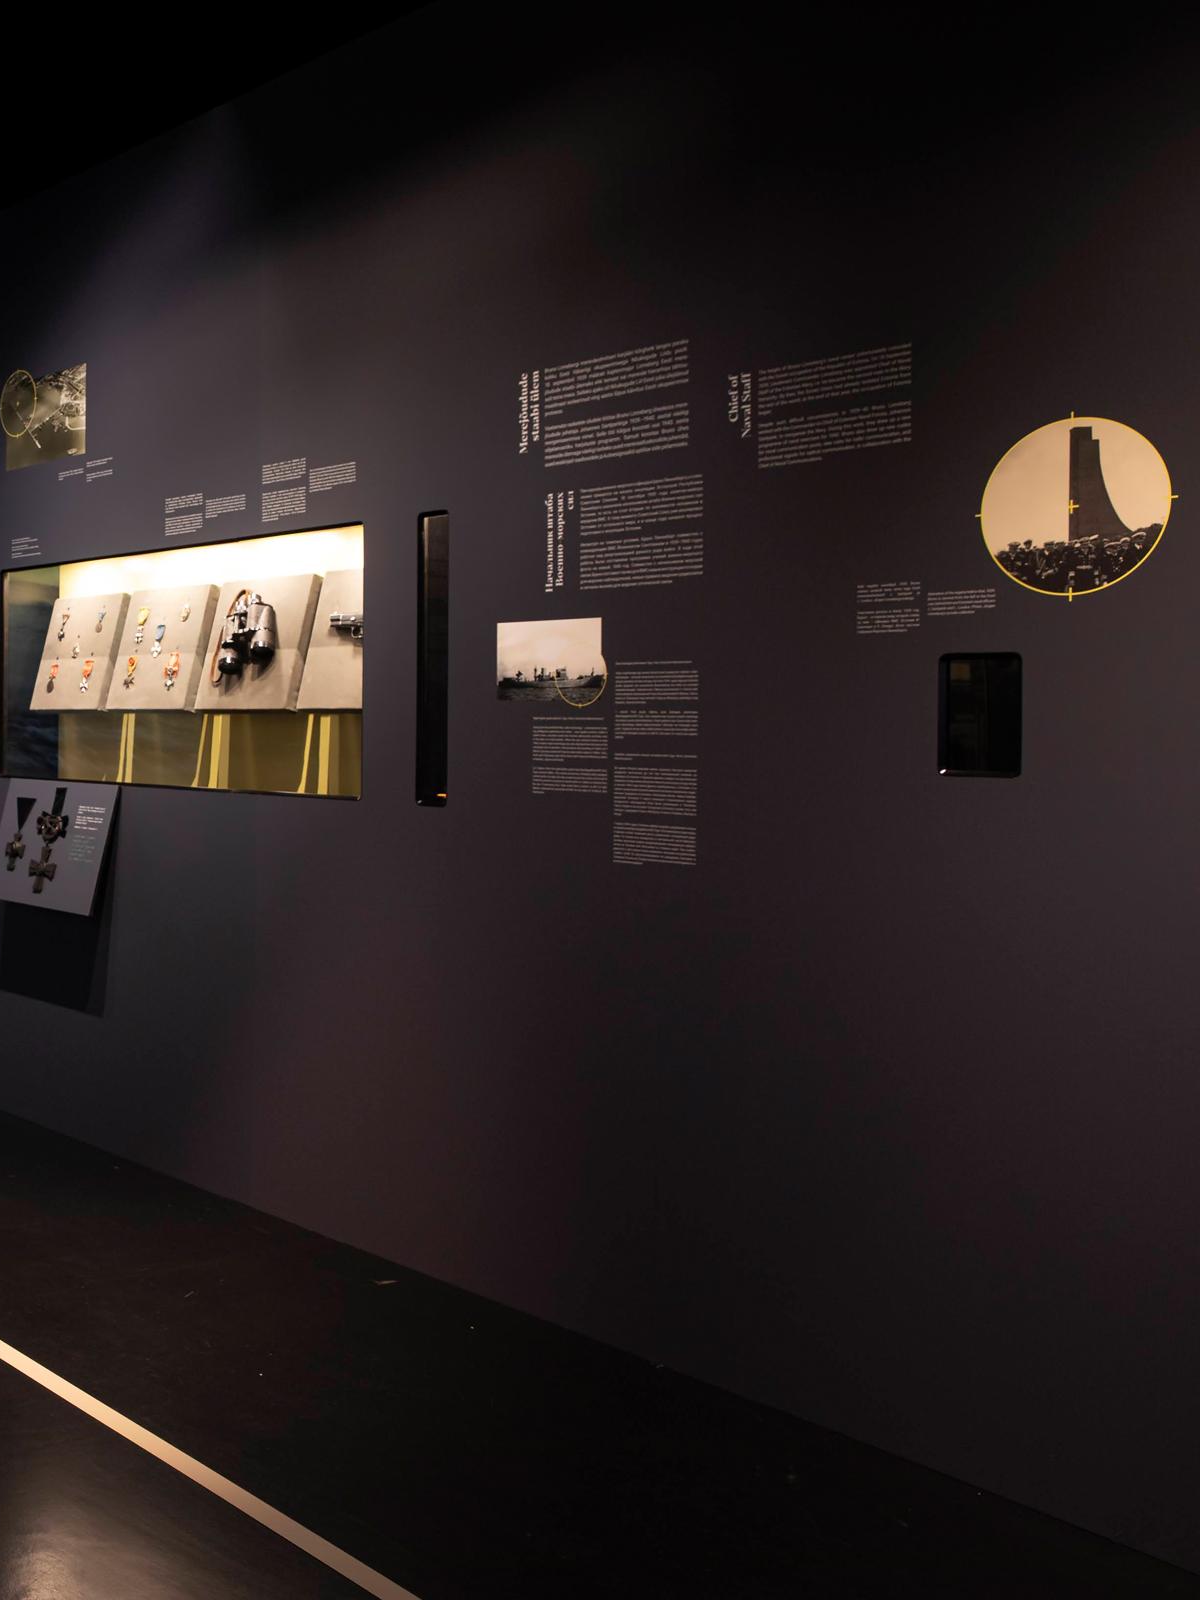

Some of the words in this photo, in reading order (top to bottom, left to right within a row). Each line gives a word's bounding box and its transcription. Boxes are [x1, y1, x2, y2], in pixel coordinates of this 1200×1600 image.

[530, 370, 540, 402] ülem
[728, 374, 739, 389] of
[741, 373, 752, 402] Staff
[519, 372, 529, 455] Merejõudude
[531, 403, 540, 442] staabi
[728, 391, 739, 423] Chief
[741, 402, 752, 439] Naval
[544, 492, 554, 528] штаба
[567, 490, 575, 511] сил
[545, 530, 554, 593] Начальник
